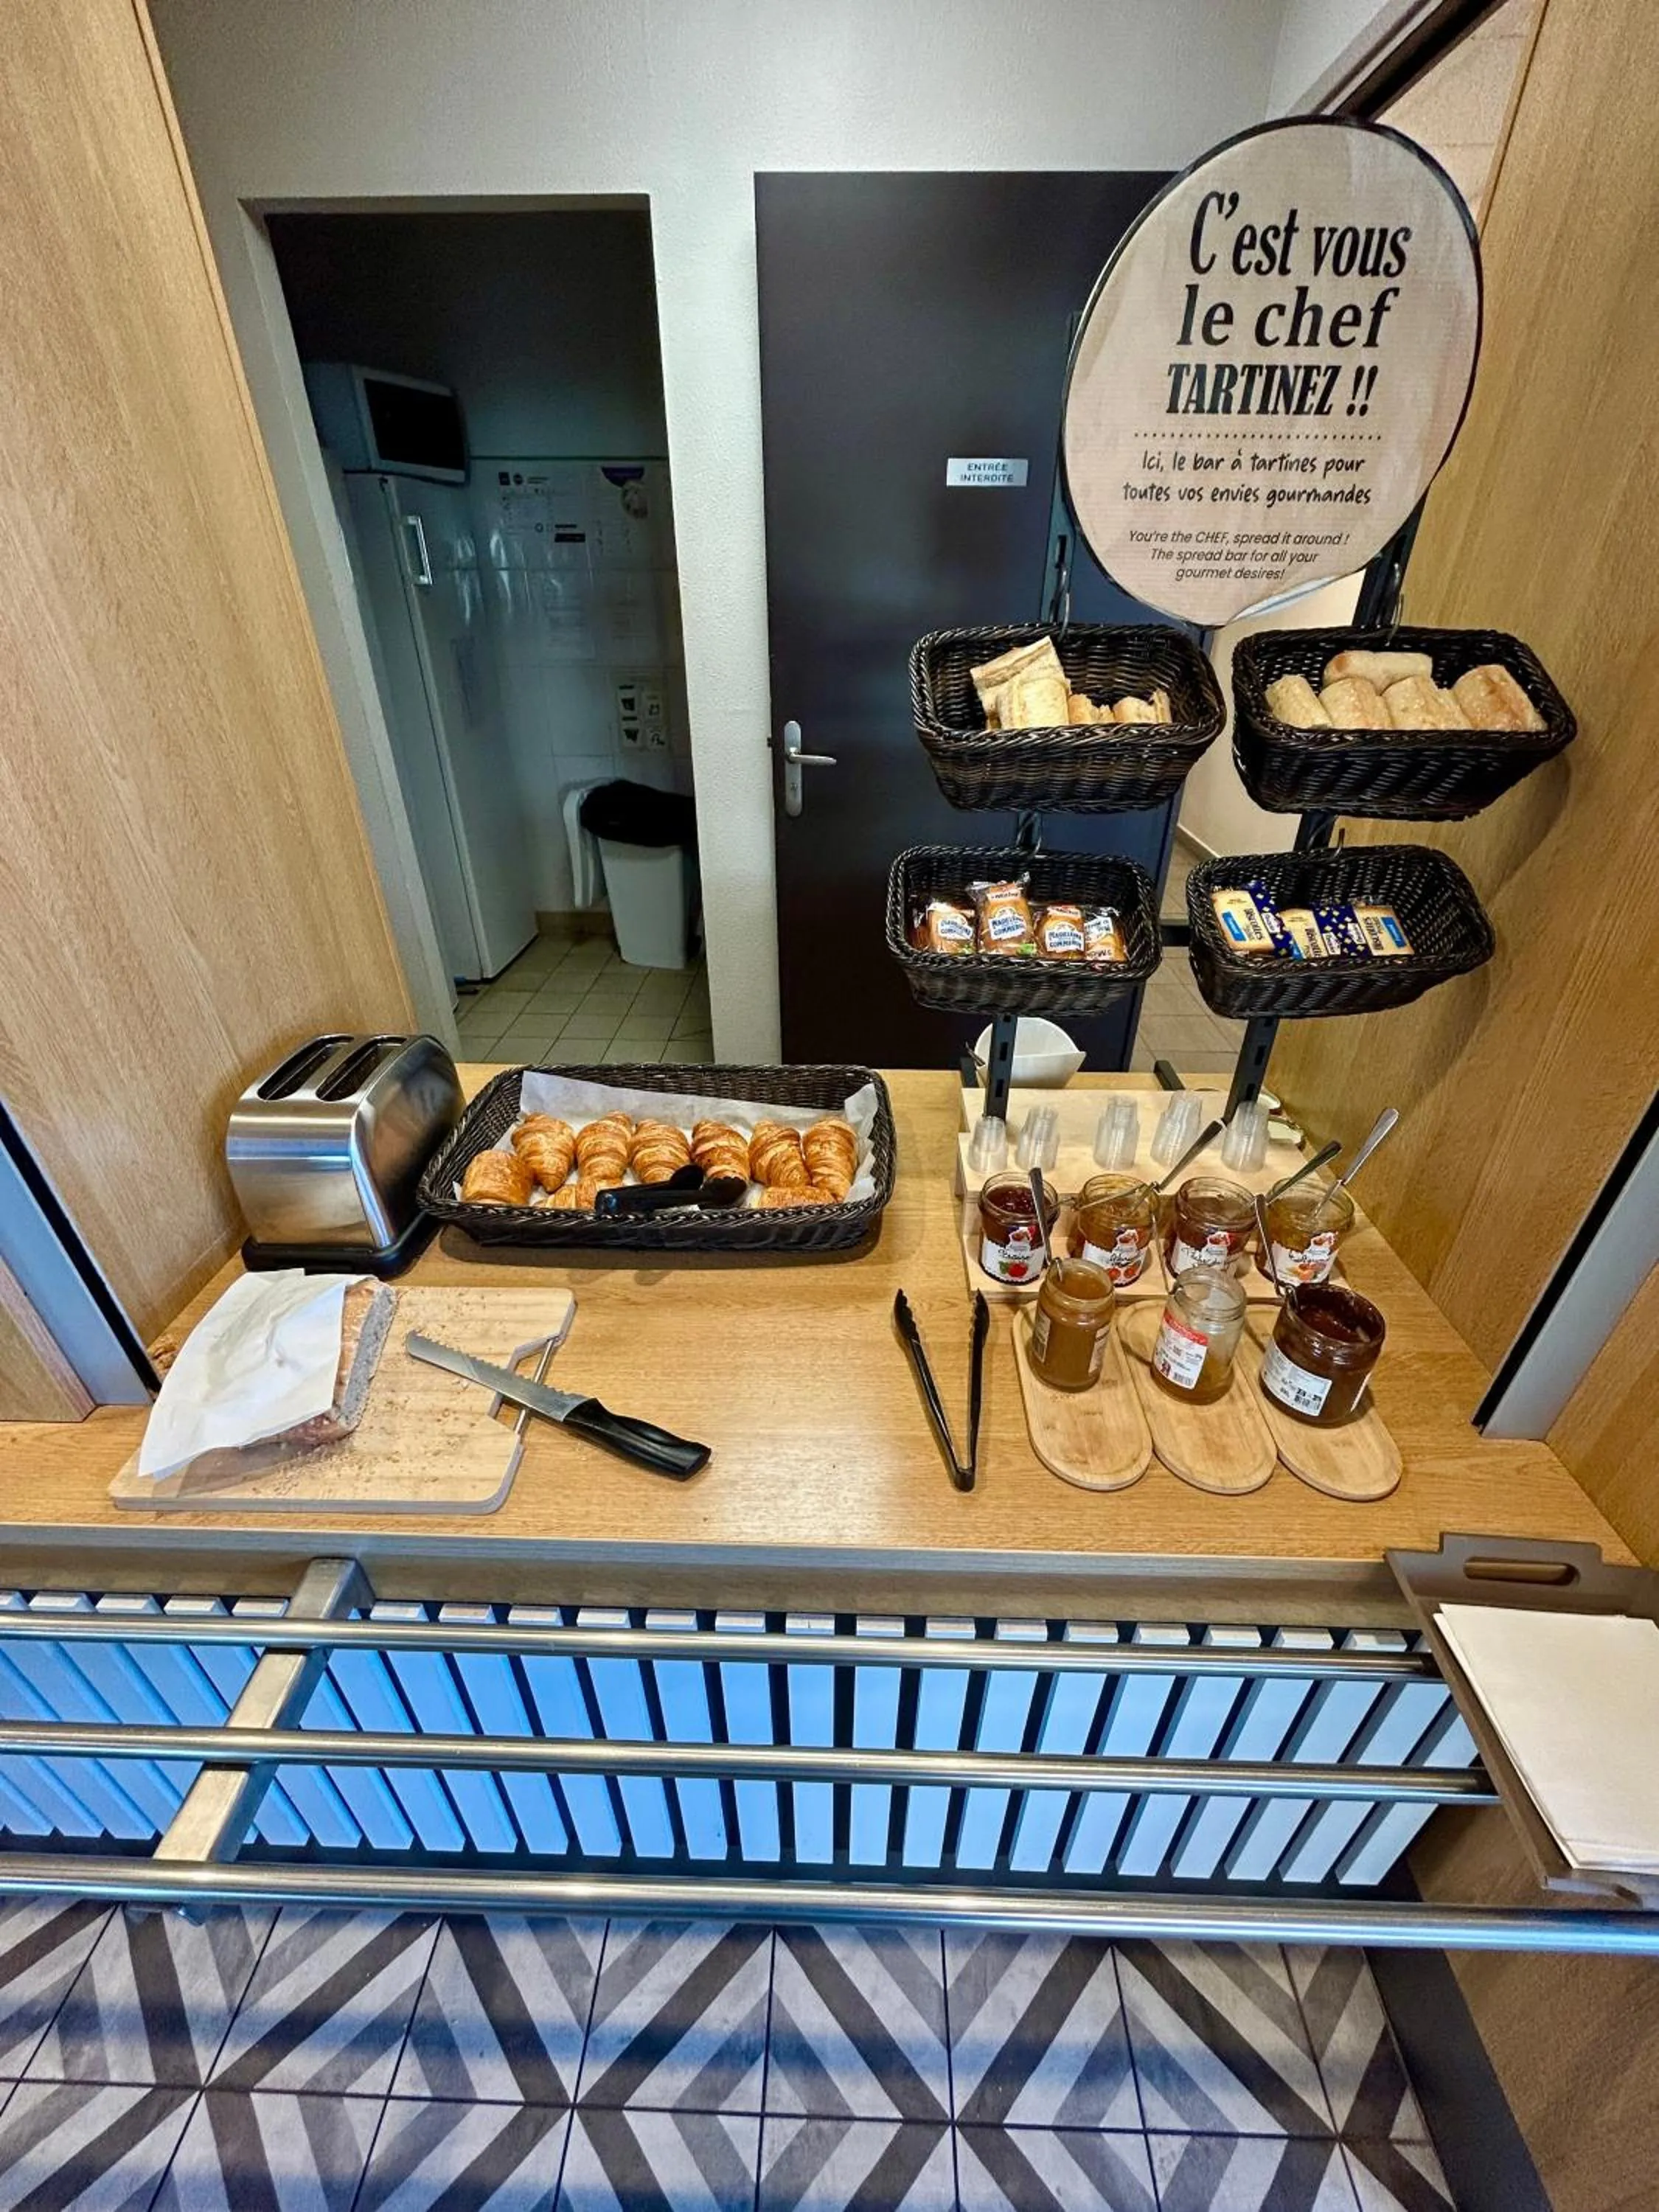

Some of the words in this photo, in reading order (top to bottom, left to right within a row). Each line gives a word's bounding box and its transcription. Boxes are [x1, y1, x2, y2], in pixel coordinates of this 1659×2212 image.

[1190, 190, 1300, 276] C'est
[1313, 226, 1413, 279] vous
[1176, 283, 1234, 347] le
[1254, 285, 1400, 348] chef
[1166, 364, 1342, 415] TARTINEZ
[1346, 365, 1379, 417] !!
[959, 473, 1015, 483] INTERDITE
[1142, 450, 1164, 473] Ici,
[1172, 451, 1186, 471] le
[1193, 452, 1225, 471] bar
[1251, 452, 1318, 473] tartines
[1323, 457, 1366, 479] pour
[1123, 481, 1171, 501] toutes
[1178, 486, 1204, 502] vos
[1211, 483, 1260, 503] envies
[1266, 483, 1371, 509] gourmandes
[1129, 530, 1168, 543] You're
[1170, 531, 1192, 543] the
[1195, 531, 1229, 546] CHEF,
[1233, 532, 1281, 548] spread
[1281, 531, 1291, 544] it
[1293, 532, 1343, 546] around
[1151, 548, 1174, 560] The
[1176, 549, 1223, 564] spread
[1225, 549, 1248, 562] bar
[1251, 549, 1268, 562] for
[1270, 549, 1287, 563] all
[1288, 553, 1320, 566] your
[1175, 567, 1231, 582] gourmet
[1234, 567, 1286, 580] desires!
